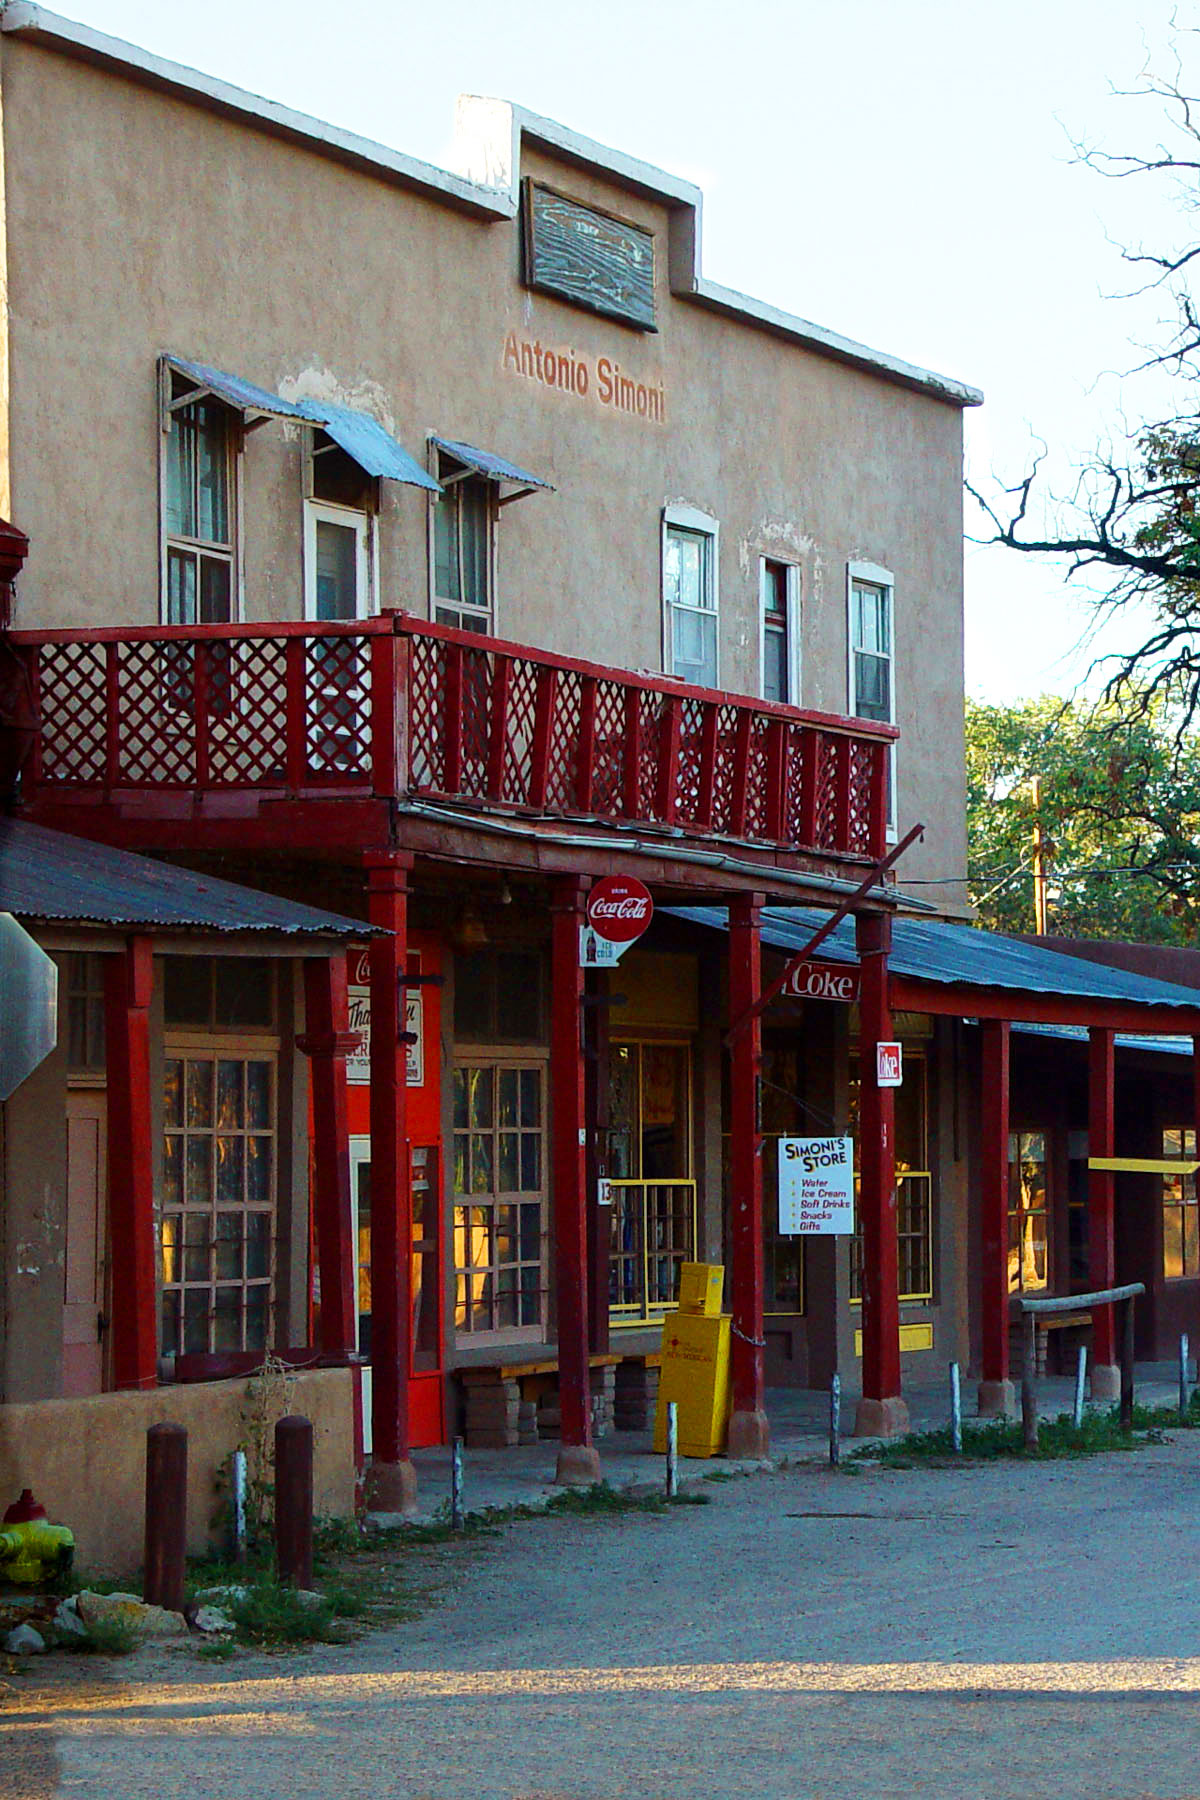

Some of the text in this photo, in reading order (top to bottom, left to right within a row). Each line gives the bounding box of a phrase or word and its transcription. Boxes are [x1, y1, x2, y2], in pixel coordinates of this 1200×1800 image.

[502, 329, 666, 425] Antonio Simoni
[792, 963, 853, 998] Coke
[785, 1138, 846, 1160] SIMONI'S
[802, 1152, 847, 1173] STORE
[802, 1179, 829, 1188] Water
[801, 1189, 847, 1198] Ice Cream
[800, 1200, 851, 1209] Soft Drinks
[800, 1211, 833, 1220] Snacks
[800, 1222, 821, 1231] Gifts
